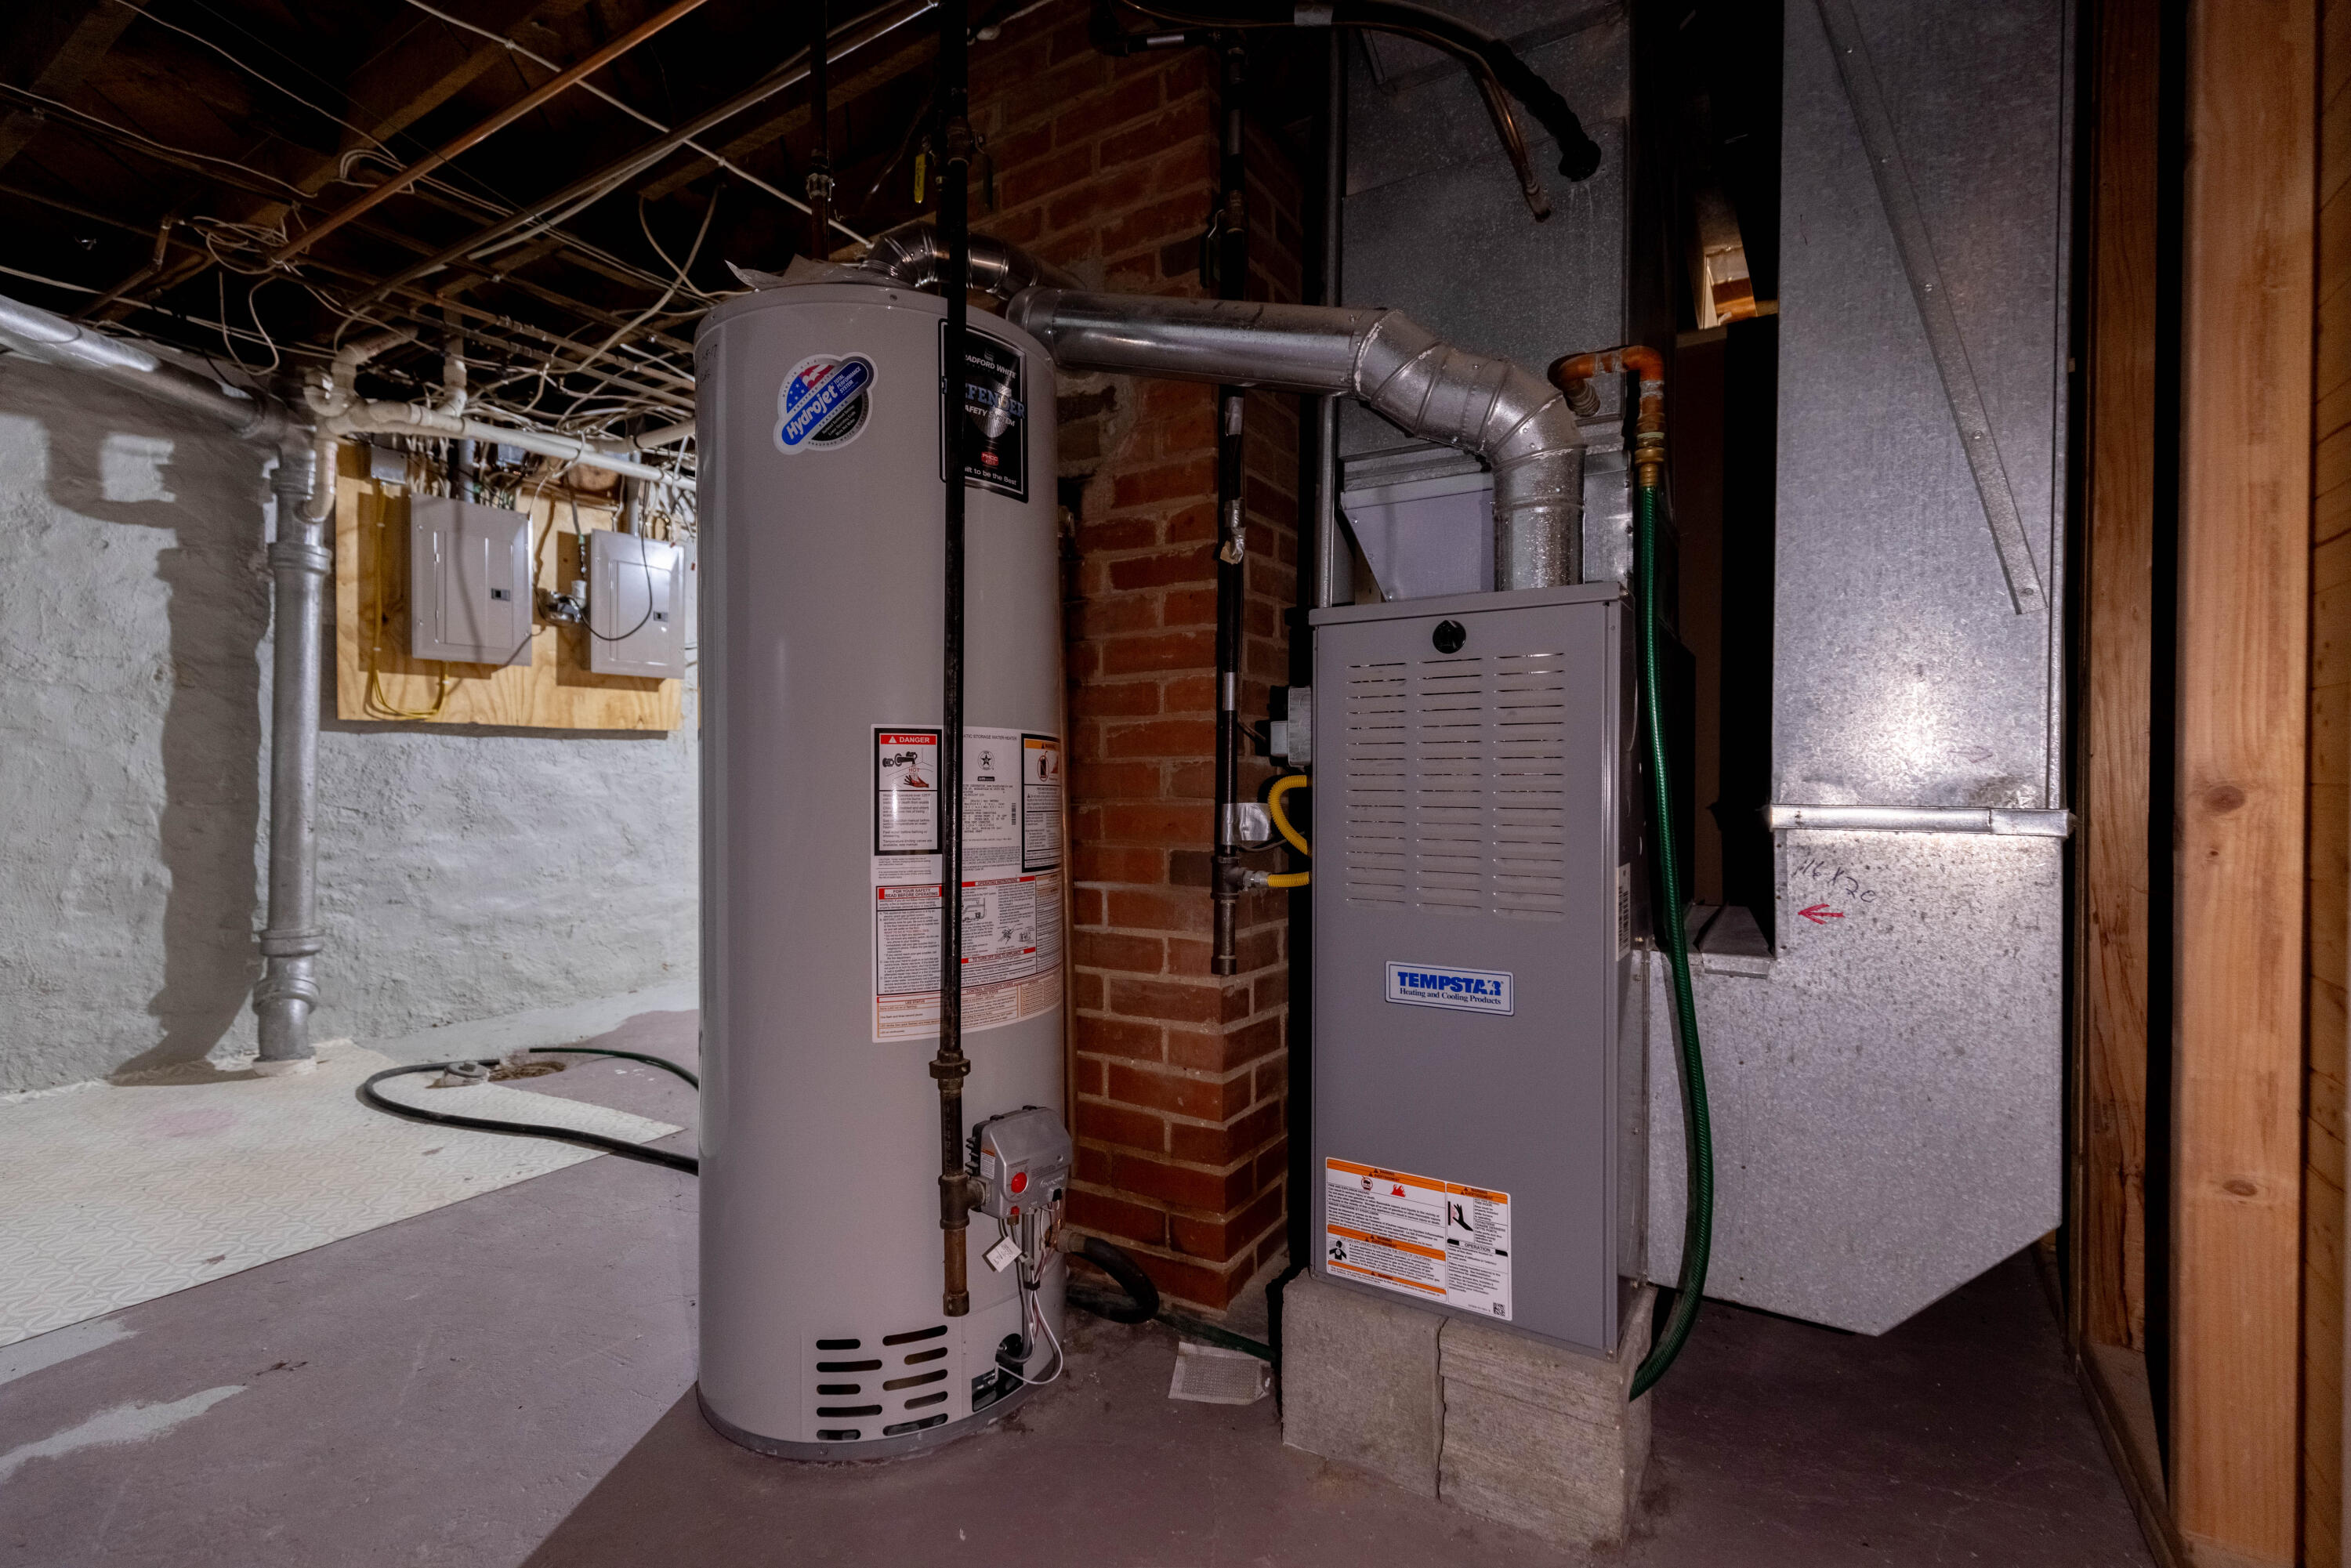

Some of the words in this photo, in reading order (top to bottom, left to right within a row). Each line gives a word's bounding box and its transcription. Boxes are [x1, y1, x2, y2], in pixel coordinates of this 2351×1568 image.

[965, 354, 994, 369] ADFORD
[997, 364, 1016, 378] WHITE
[834, 374, 845, 386] TOTAL
[837, 366, 861, 389] PERFORMANCE
[840, 380, 854, 393] SYSTEM
[942, 378, 1026, 421] FENDER
[786, 382, 839, 440] Hydrojet
[965, 404, 988, 416] AFETY
[982, 452, 999, 461] PHCC
[1004, 476, 1016, 485] Best
[1398, 972, 1502, 996] TEMPSTAR
[1400, 988, 1425, 998] Heating
[1442, 993, 1468, 1002] Cooling
[1470, 995, 1501, 1005] Products
[1465, 1243, 1491, 1252] OPERATION
